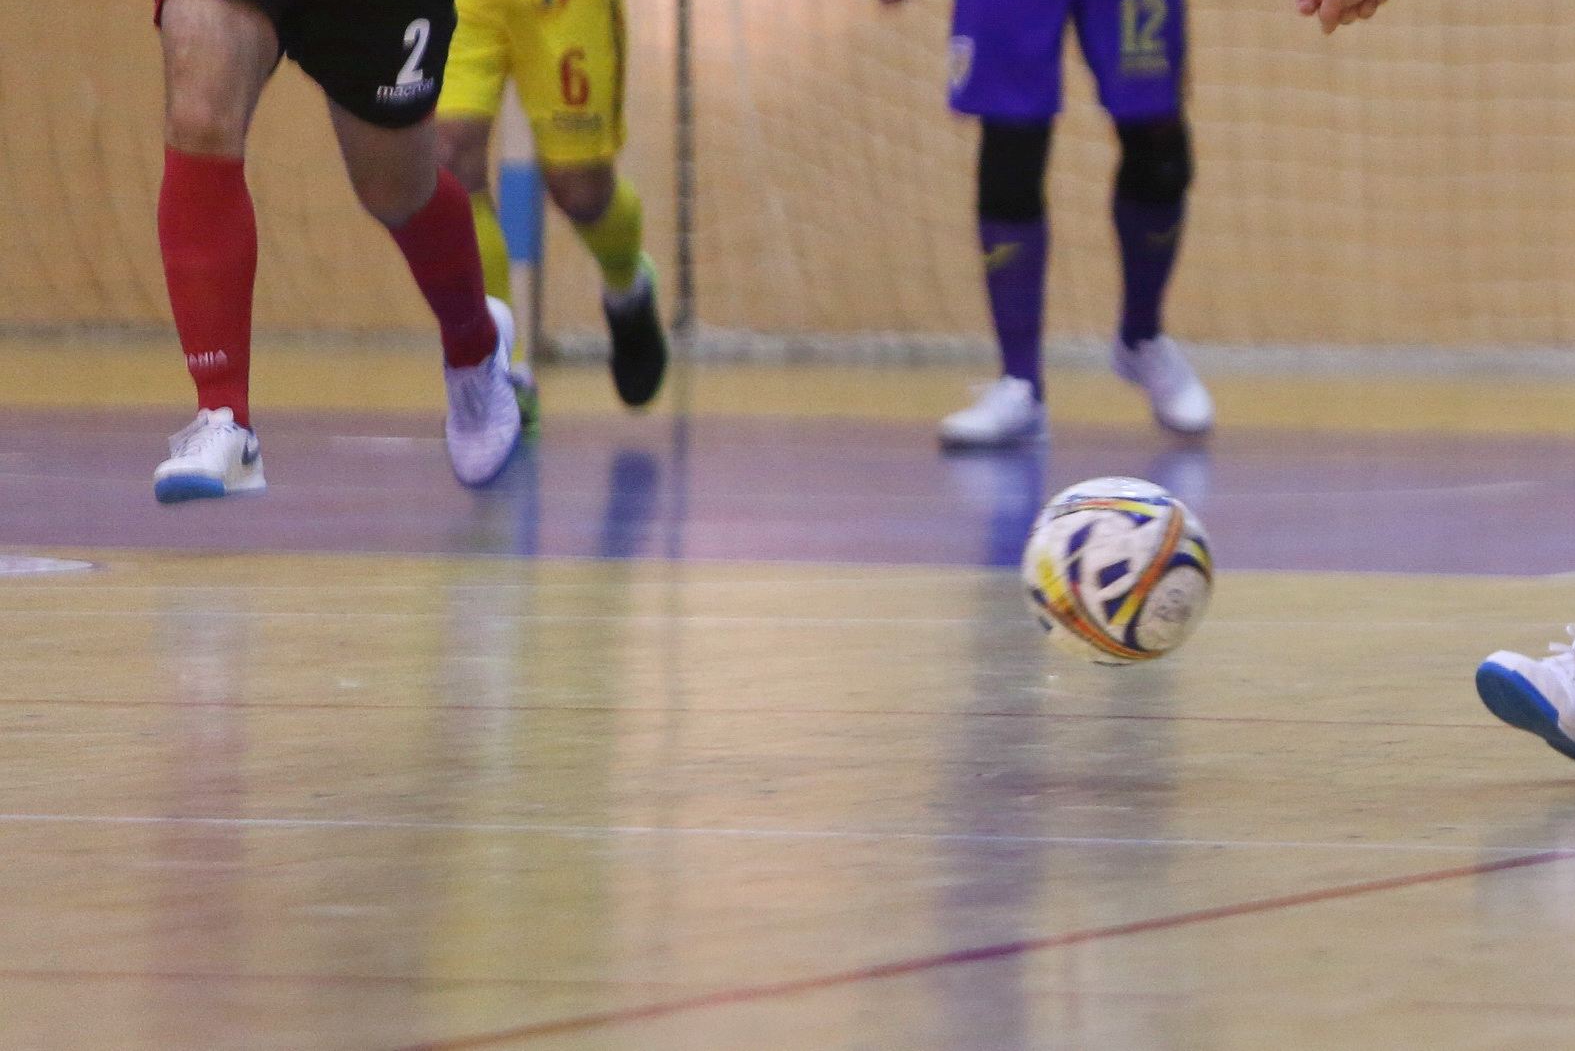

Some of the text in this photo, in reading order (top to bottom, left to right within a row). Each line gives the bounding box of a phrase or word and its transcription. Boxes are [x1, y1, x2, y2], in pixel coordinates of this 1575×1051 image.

[402, 18, 430, 86] 2
[559, 48, 590, 106] 6
[186, 349, 228, 366] ANIA
